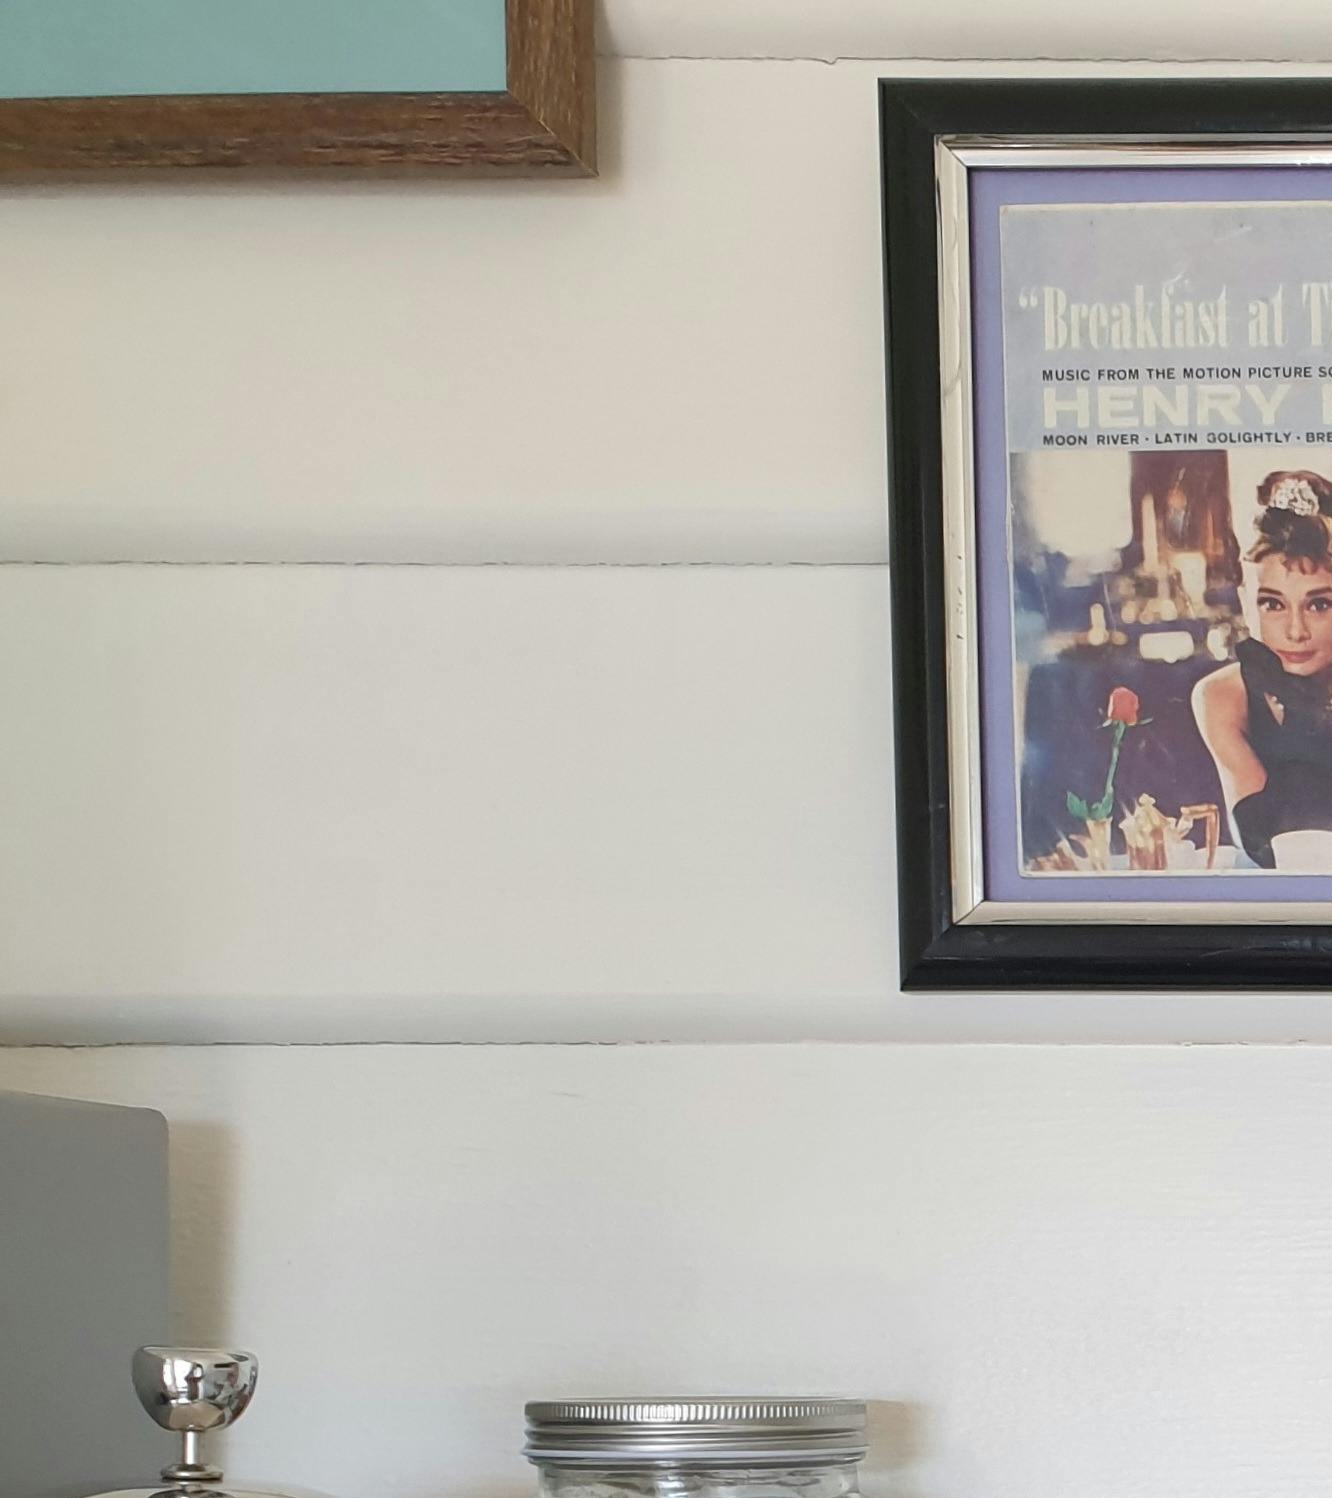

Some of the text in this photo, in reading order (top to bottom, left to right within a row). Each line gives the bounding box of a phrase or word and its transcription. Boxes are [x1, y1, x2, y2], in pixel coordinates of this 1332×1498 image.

[1248, 284, 1288, 347] at
[1042, 369, 1091, 381] MUSIC
[1097, 368, 1140, 380] FROM
[1146, 368, 1175, 380] THE
[1183, 367, 1242, 379] MOTION
[1248, 366, 1313, 378] PICTURE
[1043, 383, 1292, 430] HENRY
[1043, 434, 1088, 446] MOON
[1097, 433, 1140, 445] RIVER
[1155, 432, 1199, 444] LATIN
[1207, 431, 1292, 444] GOLIGHTLY
